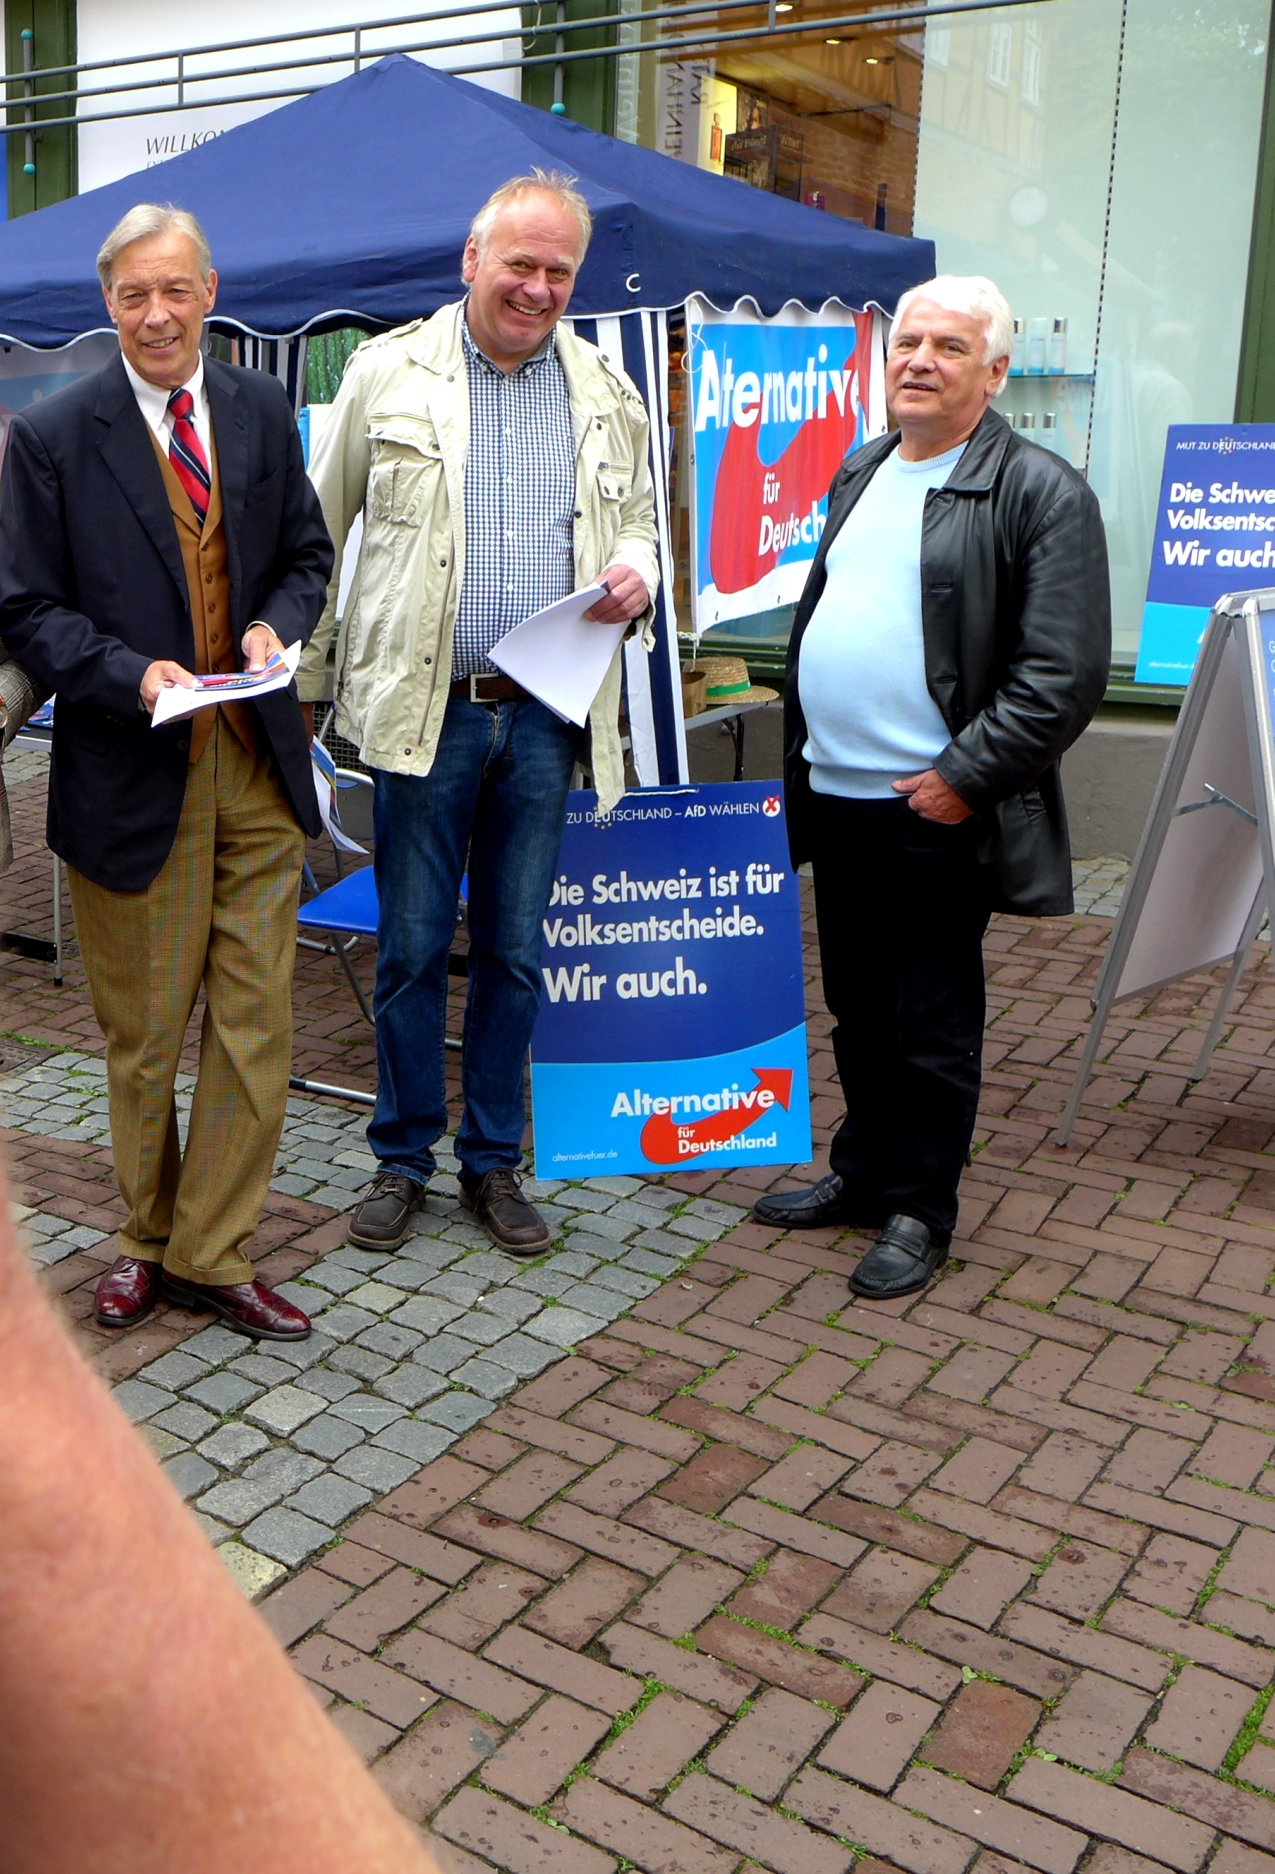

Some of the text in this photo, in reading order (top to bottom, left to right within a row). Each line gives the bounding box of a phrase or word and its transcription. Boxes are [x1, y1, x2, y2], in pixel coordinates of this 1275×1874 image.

[695, 343, 859, 432] Aternative
[1176, 441, 1196, 450] MUT
[1197, 441, 1210, 450] ZU
[763, 472, 780, 505] für
[1170, 482, 1275, 504] Die Schwe
[1167, 508, 1275, 531] Volksentsc
[1163, 540, 1275, 568] Wir auch
[566, 812, 582, 824] ZU
[684, 805, 707, 818] AfD
[709, 800, 760, 816] WÄHLEN
[592, 869, 702, 904] Schweiz
[709, 866, 739, 898] ist
[745, 863, 784, 895] für
[543, 904, 764, 947] Volksentscheide.
[542, 956, 707, 1003] Wir auch.
[610, 1083, 775, 1118] Alternative
[677, 1126, 695, 1139] für
[678, 1132, 777, 1154] Deutschland
[552, 1149, 618, 1163] alternativefuer.de
